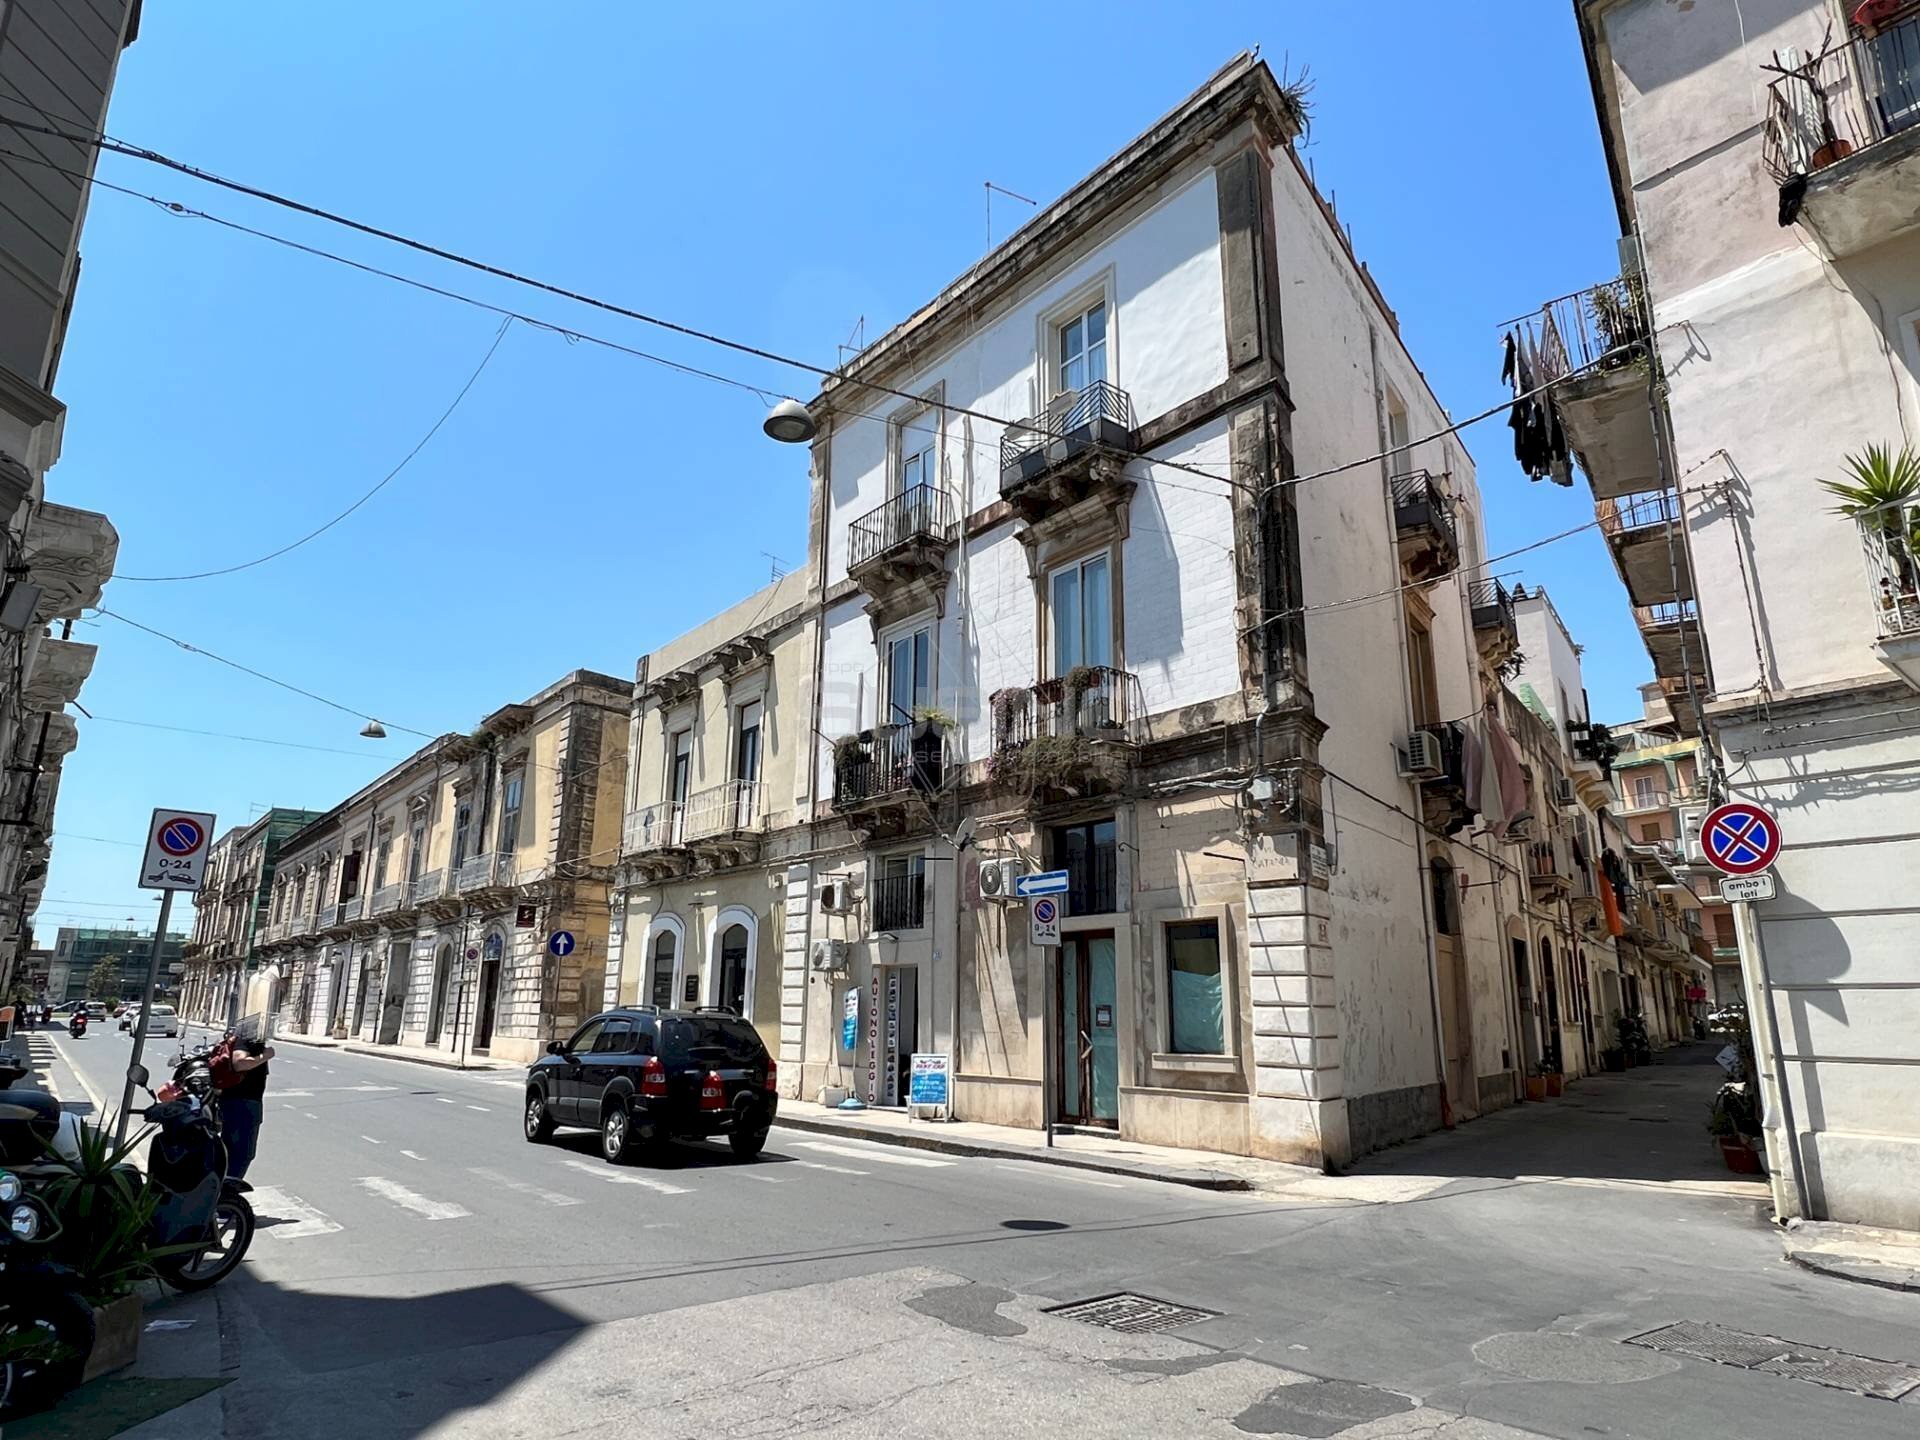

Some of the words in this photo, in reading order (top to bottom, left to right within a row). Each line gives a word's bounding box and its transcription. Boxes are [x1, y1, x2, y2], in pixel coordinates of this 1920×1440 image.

[159, 858, 192, 869] 0-24
[1728, 880, 1759, 890] ambo
[1762, 878, 1766, 886] i
[1740, 890, 1758, 899] lati
[868, 977, 879, 1103] AUTONOLEGGIO
